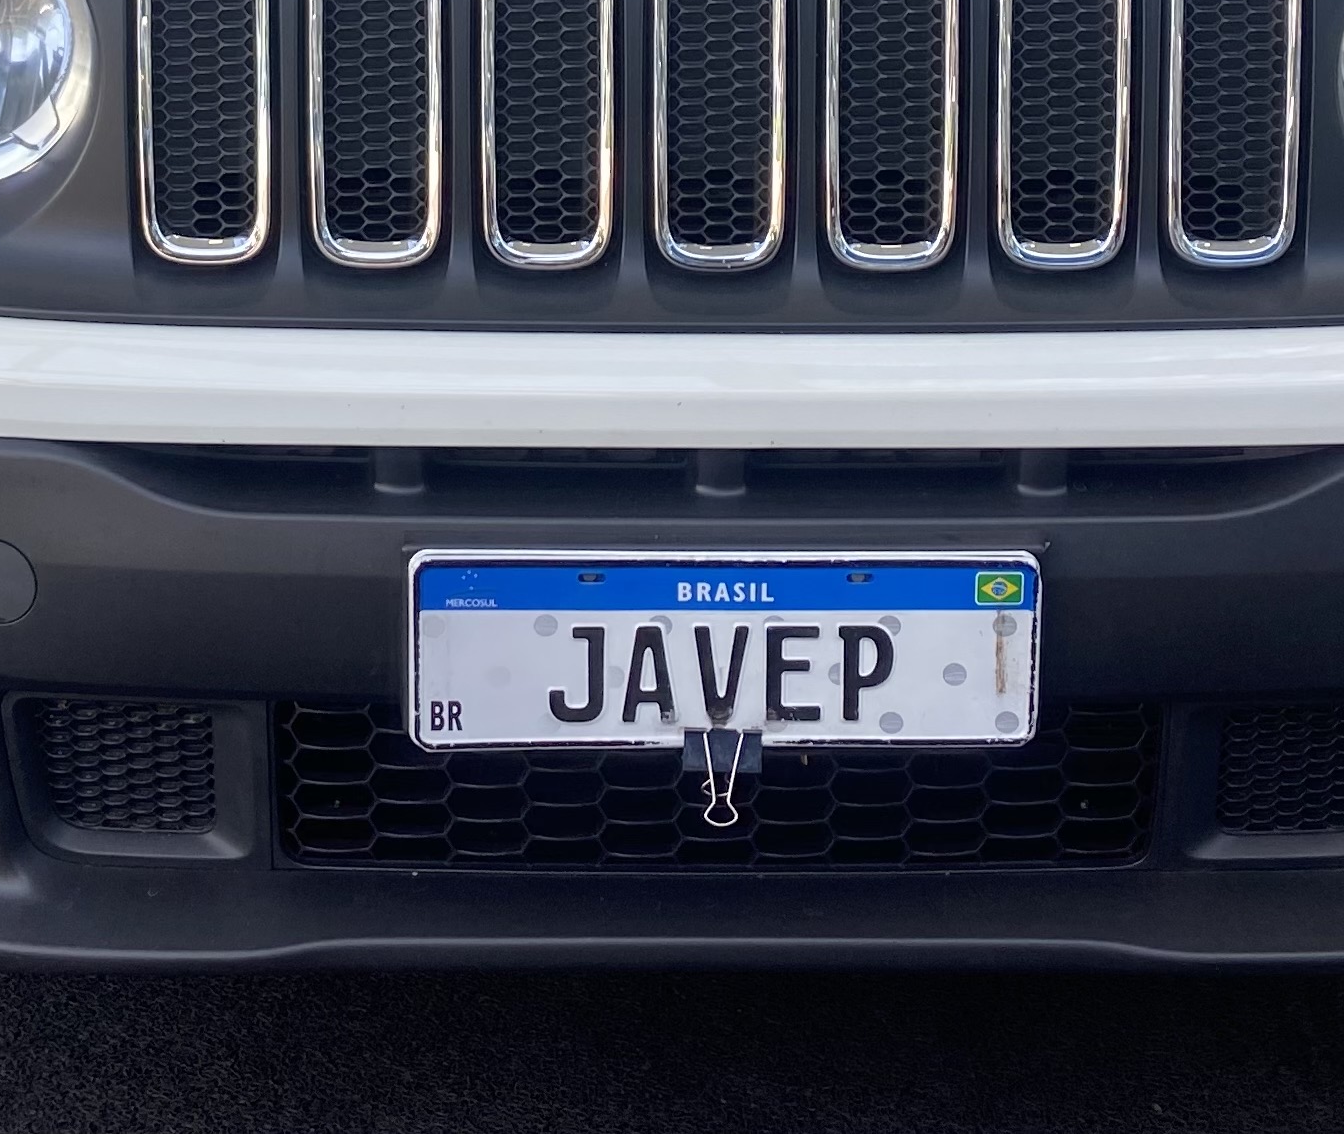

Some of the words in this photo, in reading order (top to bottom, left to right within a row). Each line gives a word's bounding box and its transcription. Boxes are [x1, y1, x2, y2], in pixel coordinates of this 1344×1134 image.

[445, 598, 498, 608] MERCOSUL
[677, 582, 775, 602] BRASIL
[549, 625, 895, 724] JAVEP
[430, 701, 463, 731] BR
